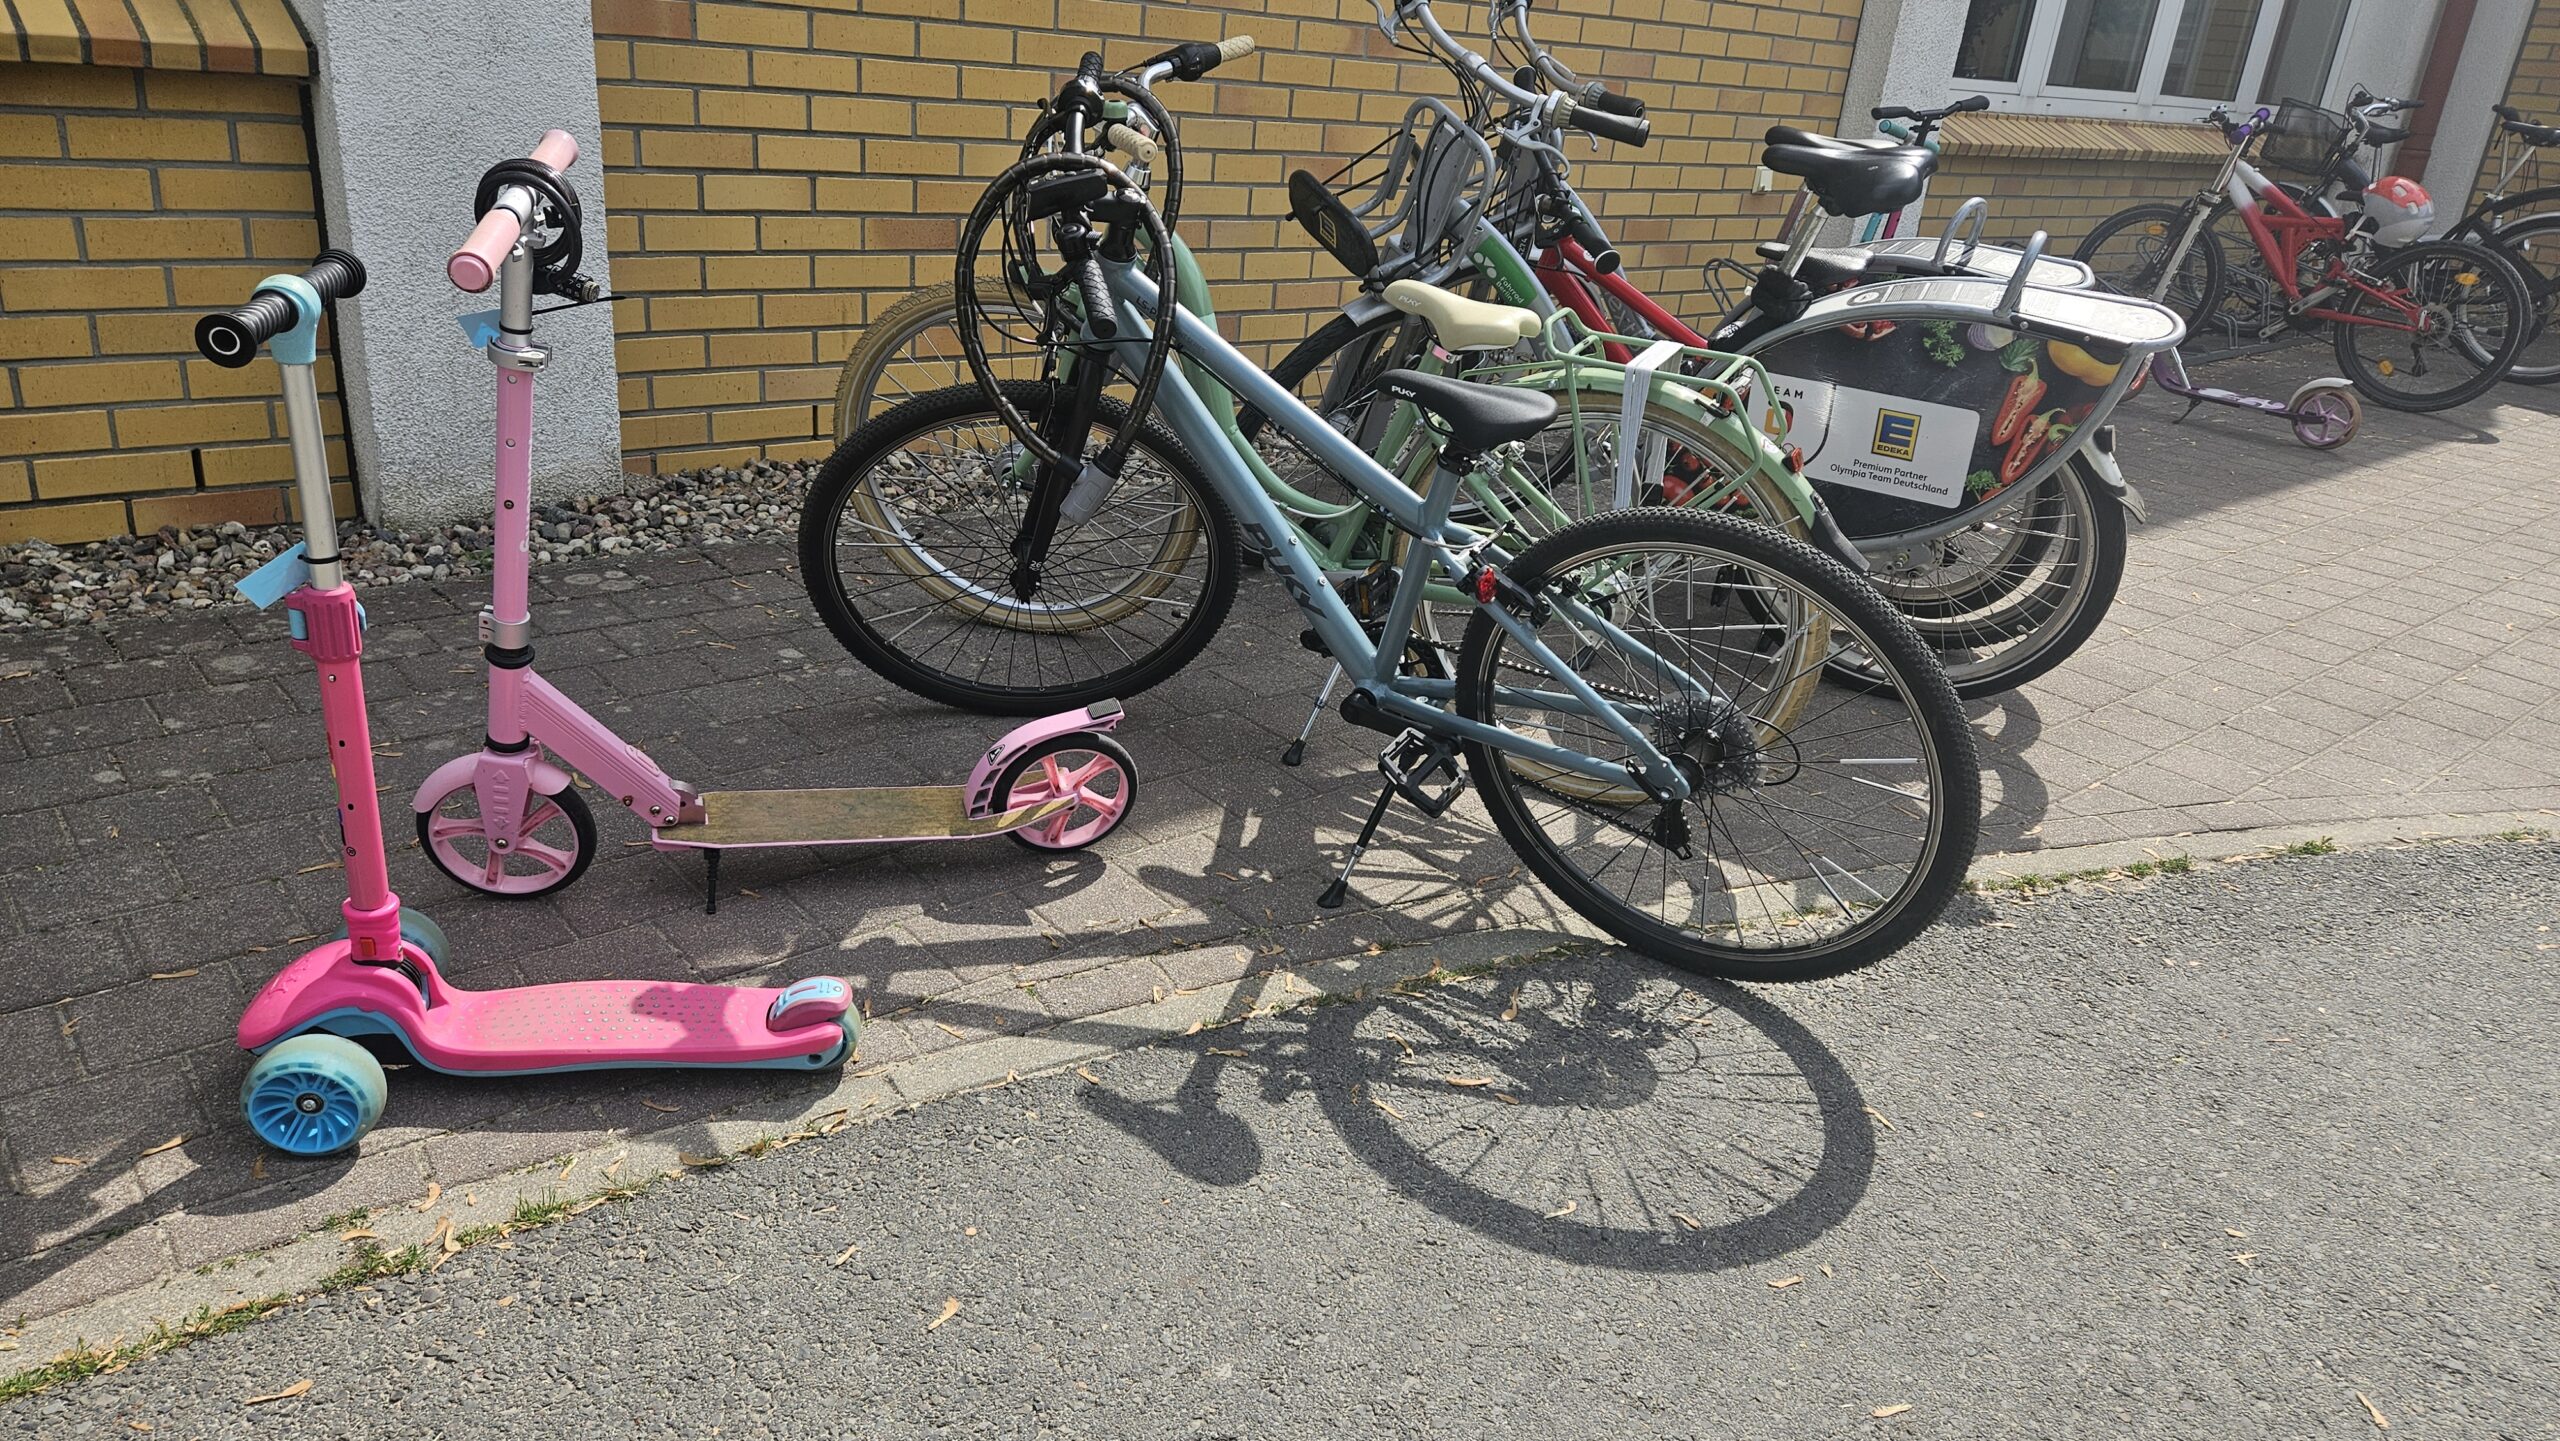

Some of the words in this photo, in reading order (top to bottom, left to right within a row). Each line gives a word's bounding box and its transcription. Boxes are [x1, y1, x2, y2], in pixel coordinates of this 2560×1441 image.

[1496, 281, 1513, 301] Berlin
[1500, 276, 1524, 303] Fahrrad
[1136, 297, 1157, 316] LS-P
[1391, 385, 1416, 397] PUKY
[1773, 386, 1803, 399] EAM
[1877, 444, 1909, 456] EDEKA
[1830, 464, 1866, 478] Olympia
[1868, 472, 1892, 483] Team
[1893, 477, 1948, 495] Deutschland
[1853, 459, 1892, 474] Premium
[1894, 468, 1928, 481] Partner
